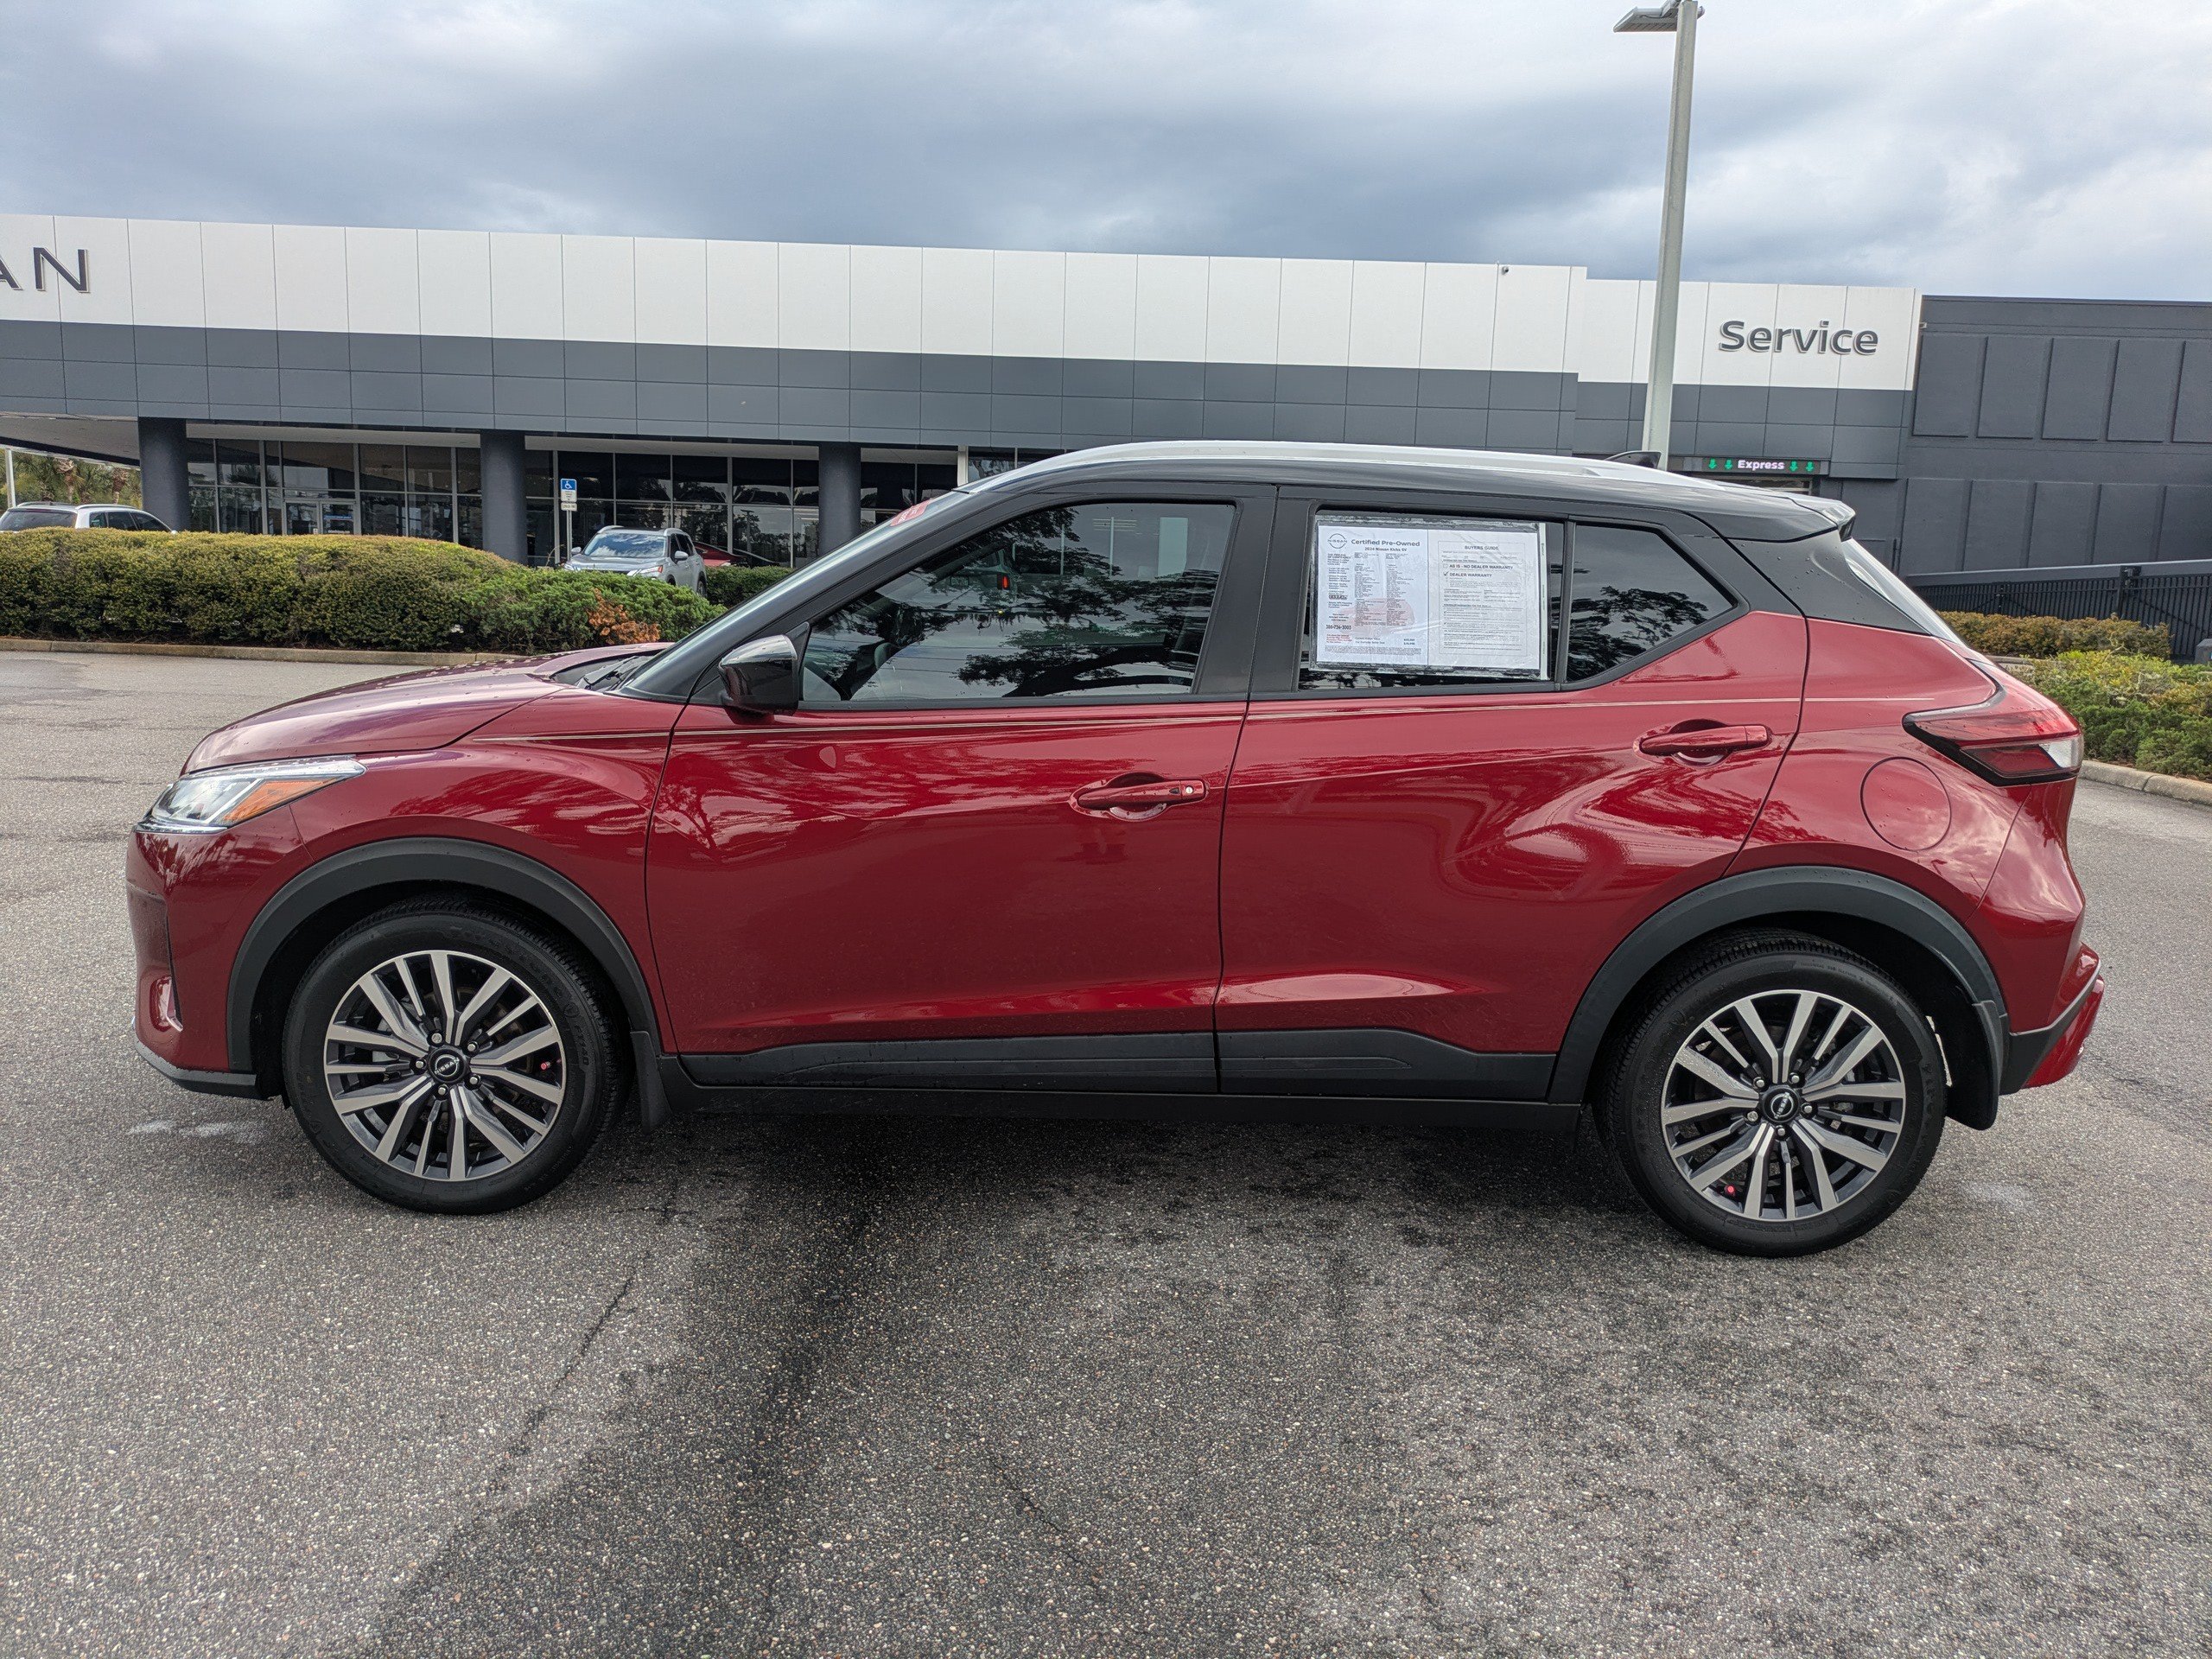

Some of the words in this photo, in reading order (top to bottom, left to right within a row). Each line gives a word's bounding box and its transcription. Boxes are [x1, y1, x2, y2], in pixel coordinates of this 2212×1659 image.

[1719, 320, 1878, 355] Service
[1737, 459, 1785, 471] Express
[434, 1057, 460, 1075] NISSAN
